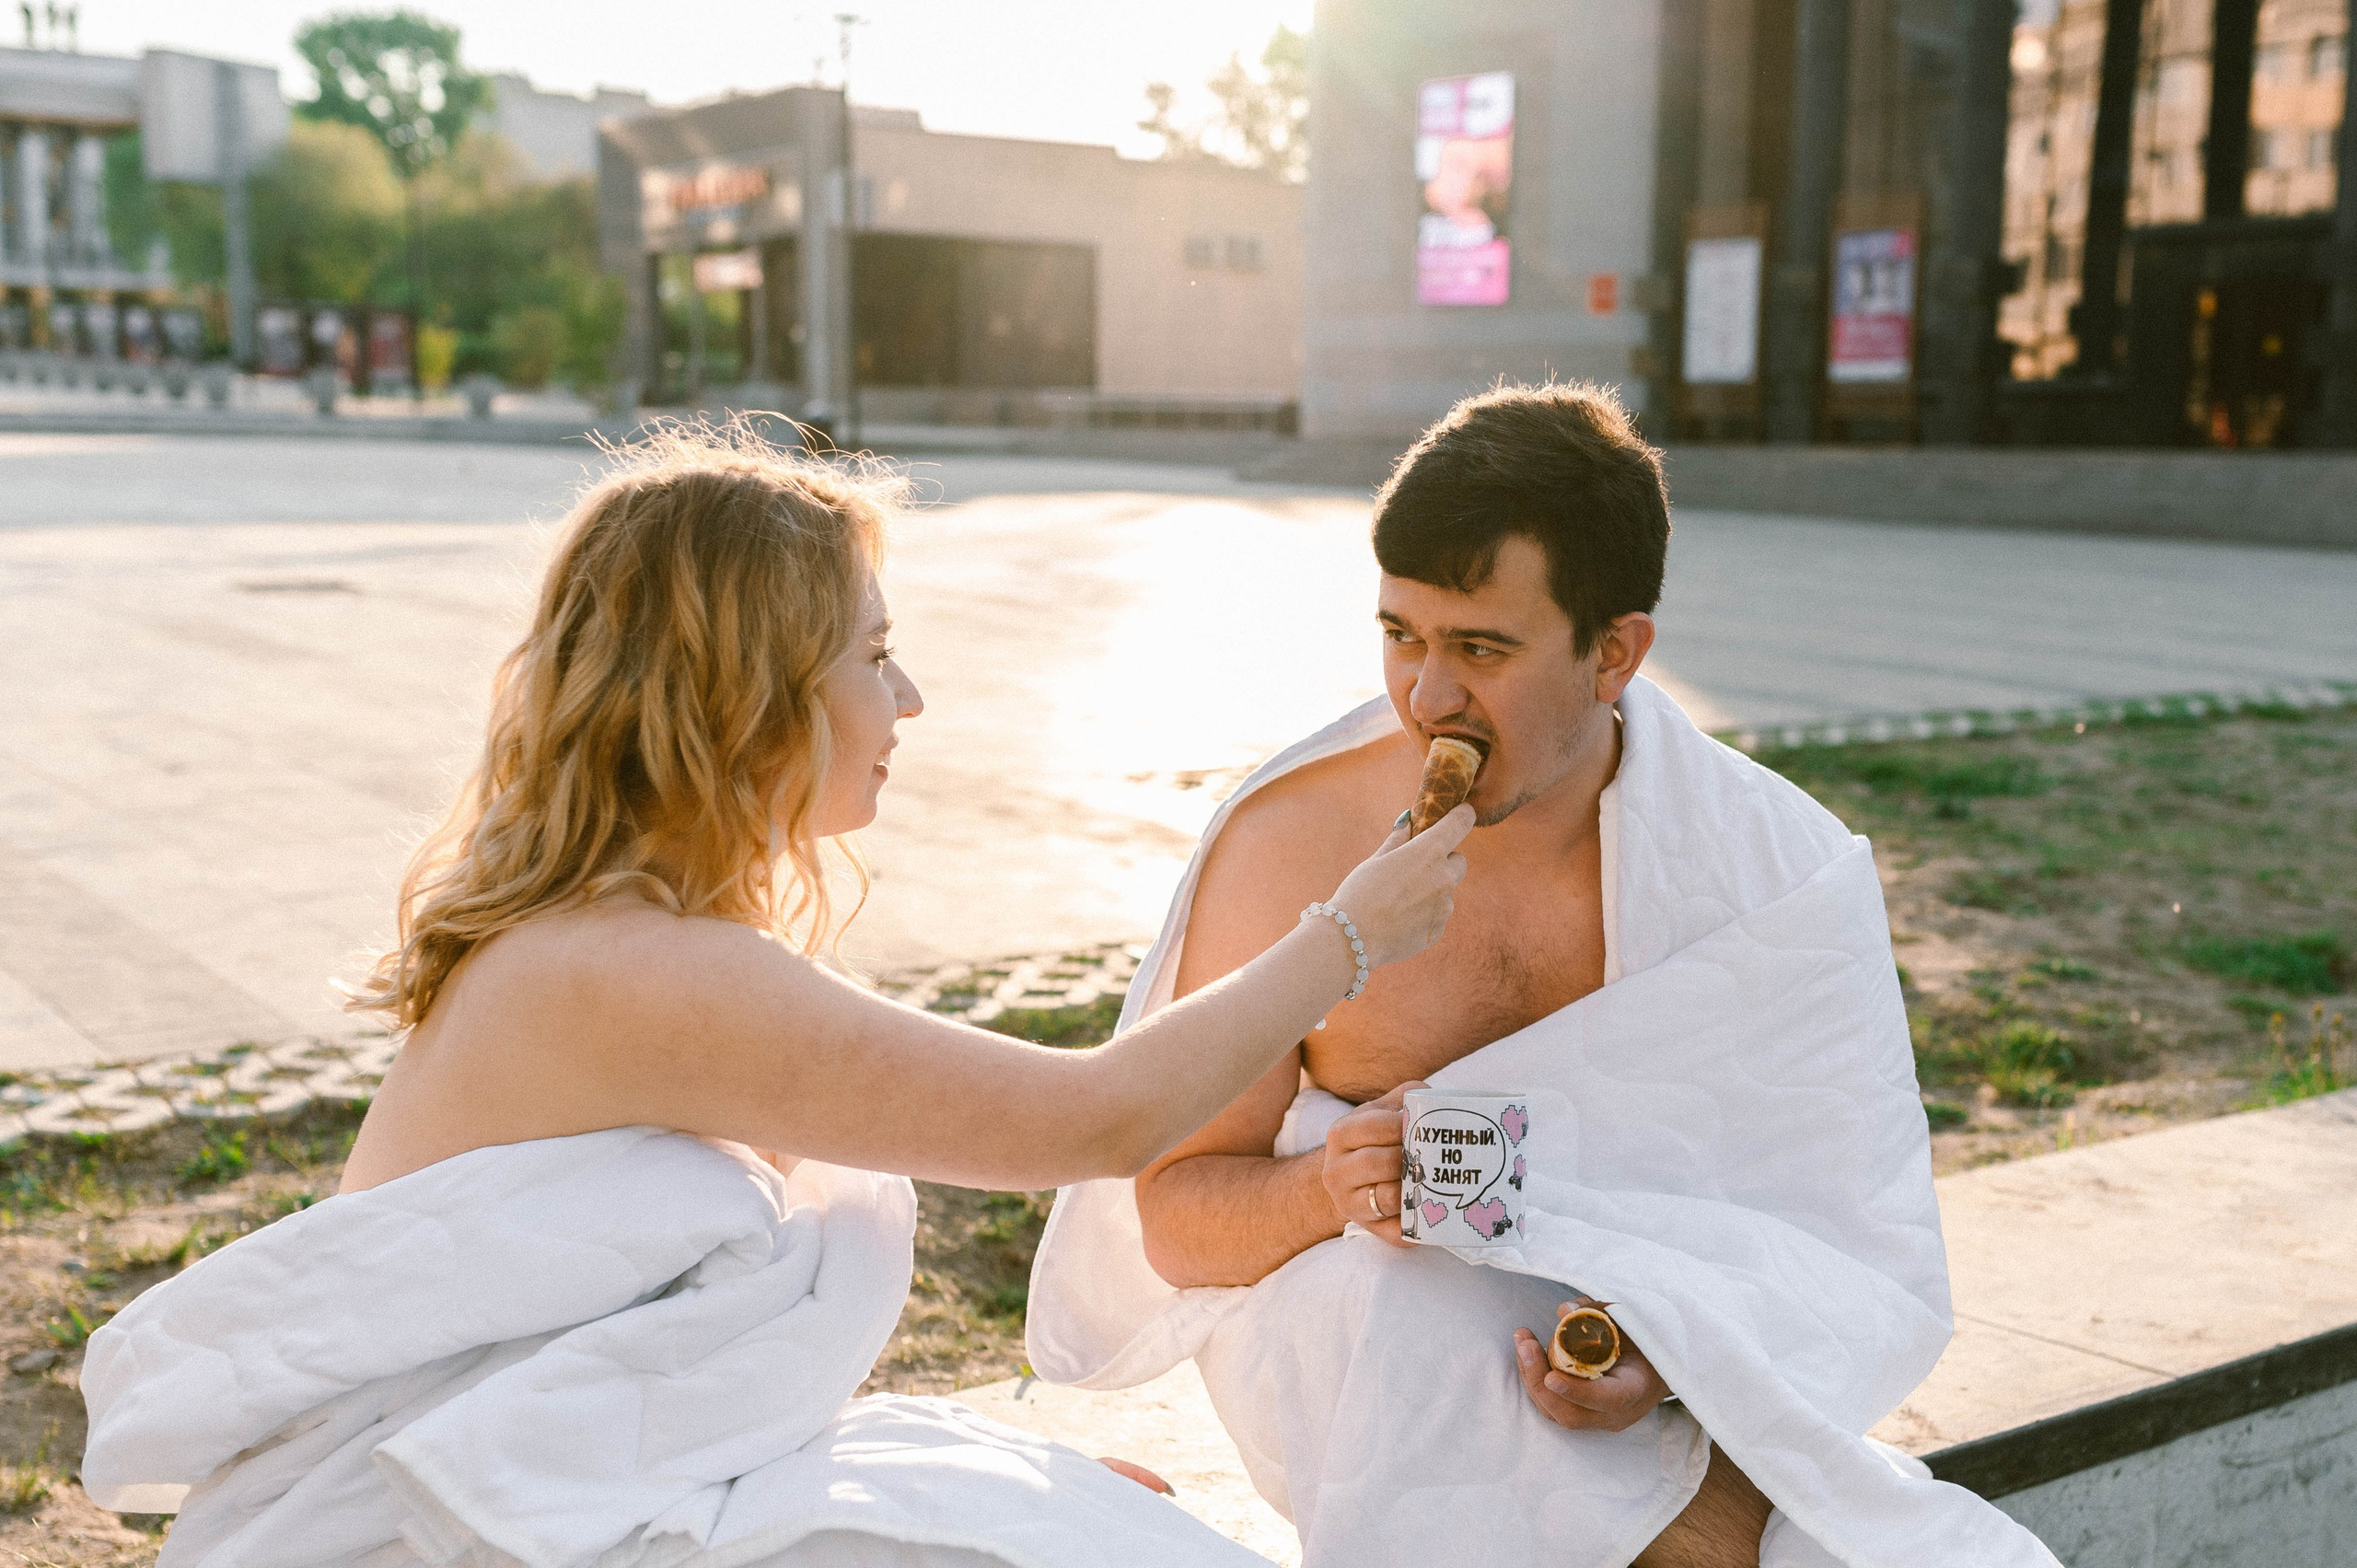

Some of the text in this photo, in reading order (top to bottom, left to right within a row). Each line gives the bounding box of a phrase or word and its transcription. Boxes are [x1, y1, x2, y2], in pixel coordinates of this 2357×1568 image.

[1414, 1126, 1496, 1146] АХУЕННЫЙ,
[1441, 1148, 1462, 1165] НО
[1432, 1167, 1482, 1185] ЗАНЯТ
